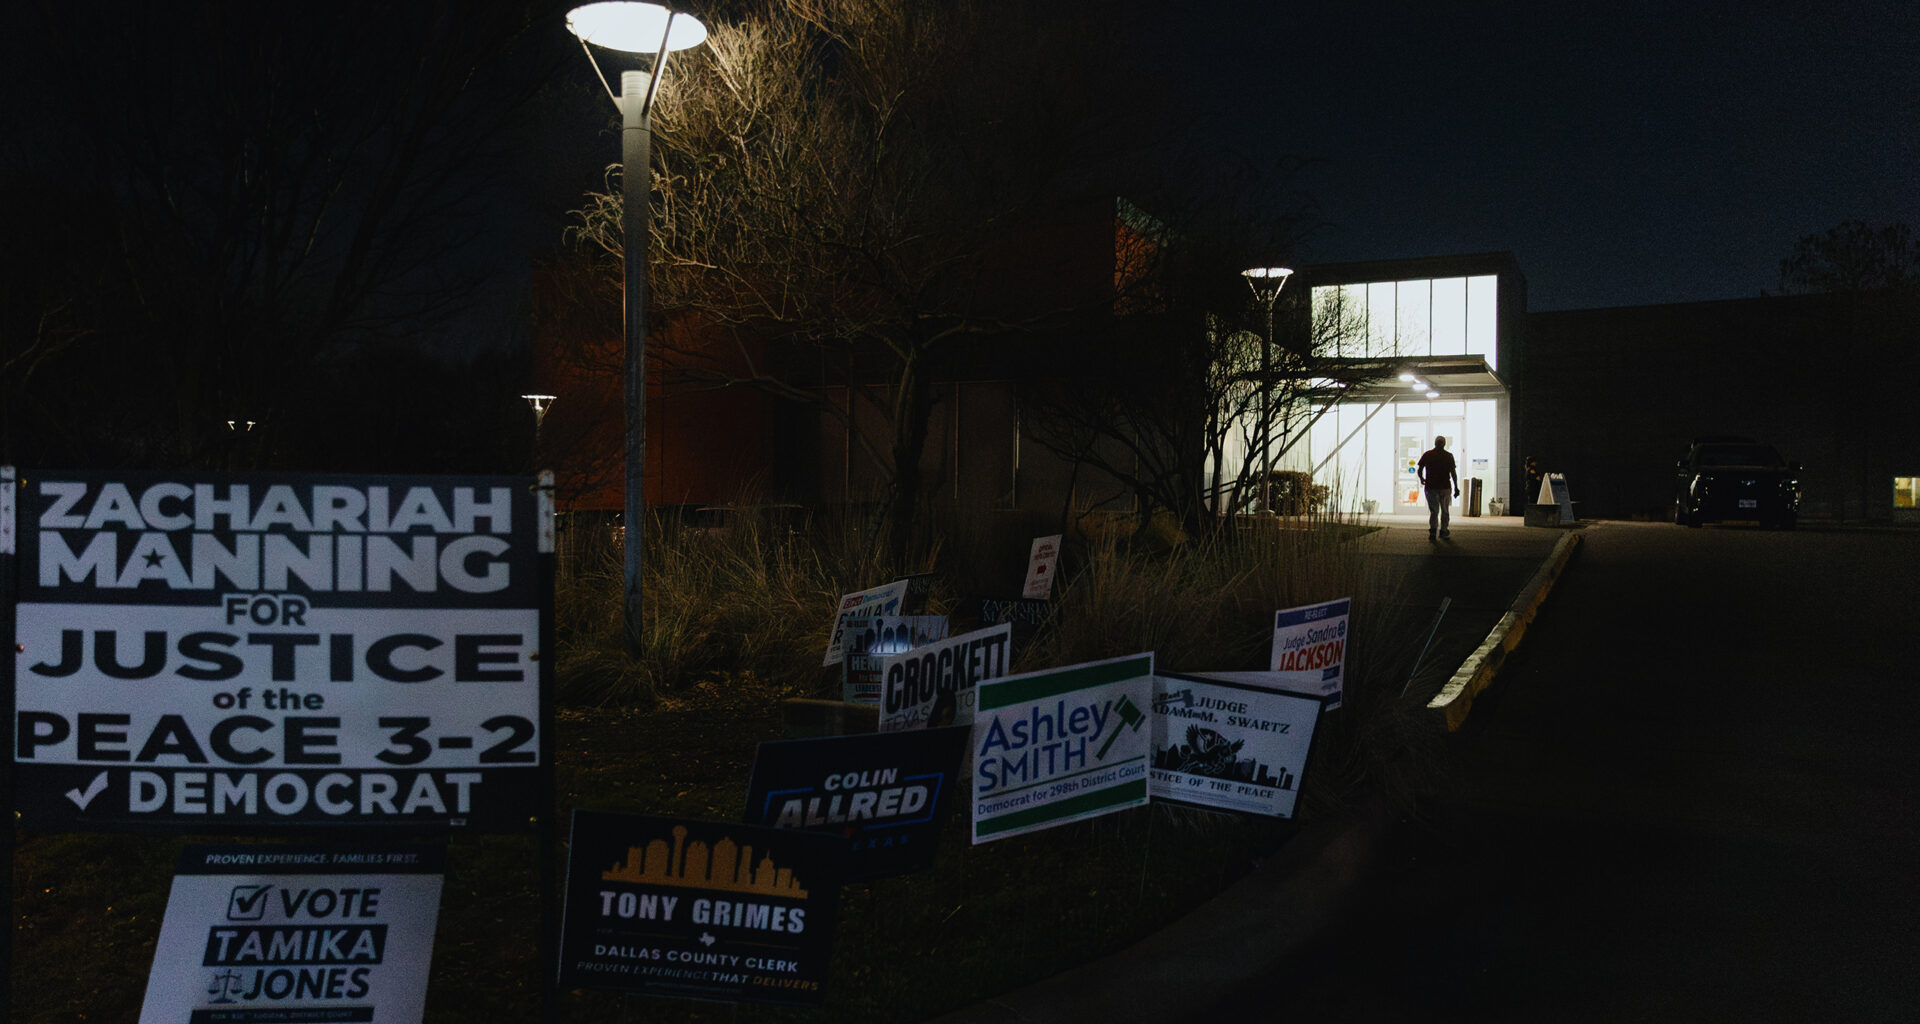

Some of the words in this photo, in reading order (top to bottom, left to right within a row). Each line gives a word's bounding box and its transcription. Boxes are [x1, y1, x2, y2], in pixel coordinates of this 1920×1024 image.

[39, 482, 511, 534] ZACHARIAH
[39, 531, 510, 593] MANNING
[225, 597, 306, 626] FOR
[1283, 635, 1305, 652] Judge
[1305, 624, 1338, 645] Sandra
[30, 630, 525, 682] JUSTICE
[1280, 639, 1344, 671] JACKSON
[885, 632, 1008, 714] CROCKETT
[213, 687, 251, 710] of
[263, 688, 324, 710] the
[1196, 697, 1248, 714] JUDGE
[17, 712, 342, 766] PEACE
[377, 715, 536, 766] 3-2
[979, 700, 1113, 757] Ashley
[1226, 715, 1291, 735] SWARTZ
[824, 768, 898, 792] COLIN
[979, 737, 1086, 793] SMITH
[129, 773, 483, 816] DEMOCRAT
[978, 795, 1031, 815] Democrat
[1032, 790, 1048, 803] for
[1050, 782, 1080, 798] 298th
[1082, 771, 1117, 789] District
[1118, 764, 1146, 778] Court
[1151, 771, 1182, 784] STICE
[1189, 777, 1204, 787] OF
[1209, 781, 1232, 792] THE
[1237, 786, 1276, 799] PEACE
[774, 785, 929, 829] ALLRED
[205, 854, 254, 864] PROVEN
[257, 853, 330, 864] EXPERIENCE.
[333, 853, 383, 864] FAMILIES
[386, 853, 419, 864] FIRST.
[851, 834, 910, 852] EXAS
[281, 888, 381, 918] VOTE
[600, 890, 679, 921] TONY
[692, 899, 807, 934] GRIMES
[215, 929, 378, 962] TAMIKA
[594, 944, 662, 961] DALLAS
[666, 951, 741, 968] COUNTY
[745, 957, 799, 974] CLERK
[243, 967, 372, 1001] JONES
[576, 961, 629, 974] PROVEN
[633, 965, 709, 981] EXPERIENCE
[711, 971, 750, 985] THAT
[752, 976, 820, 992] DELIVERS
